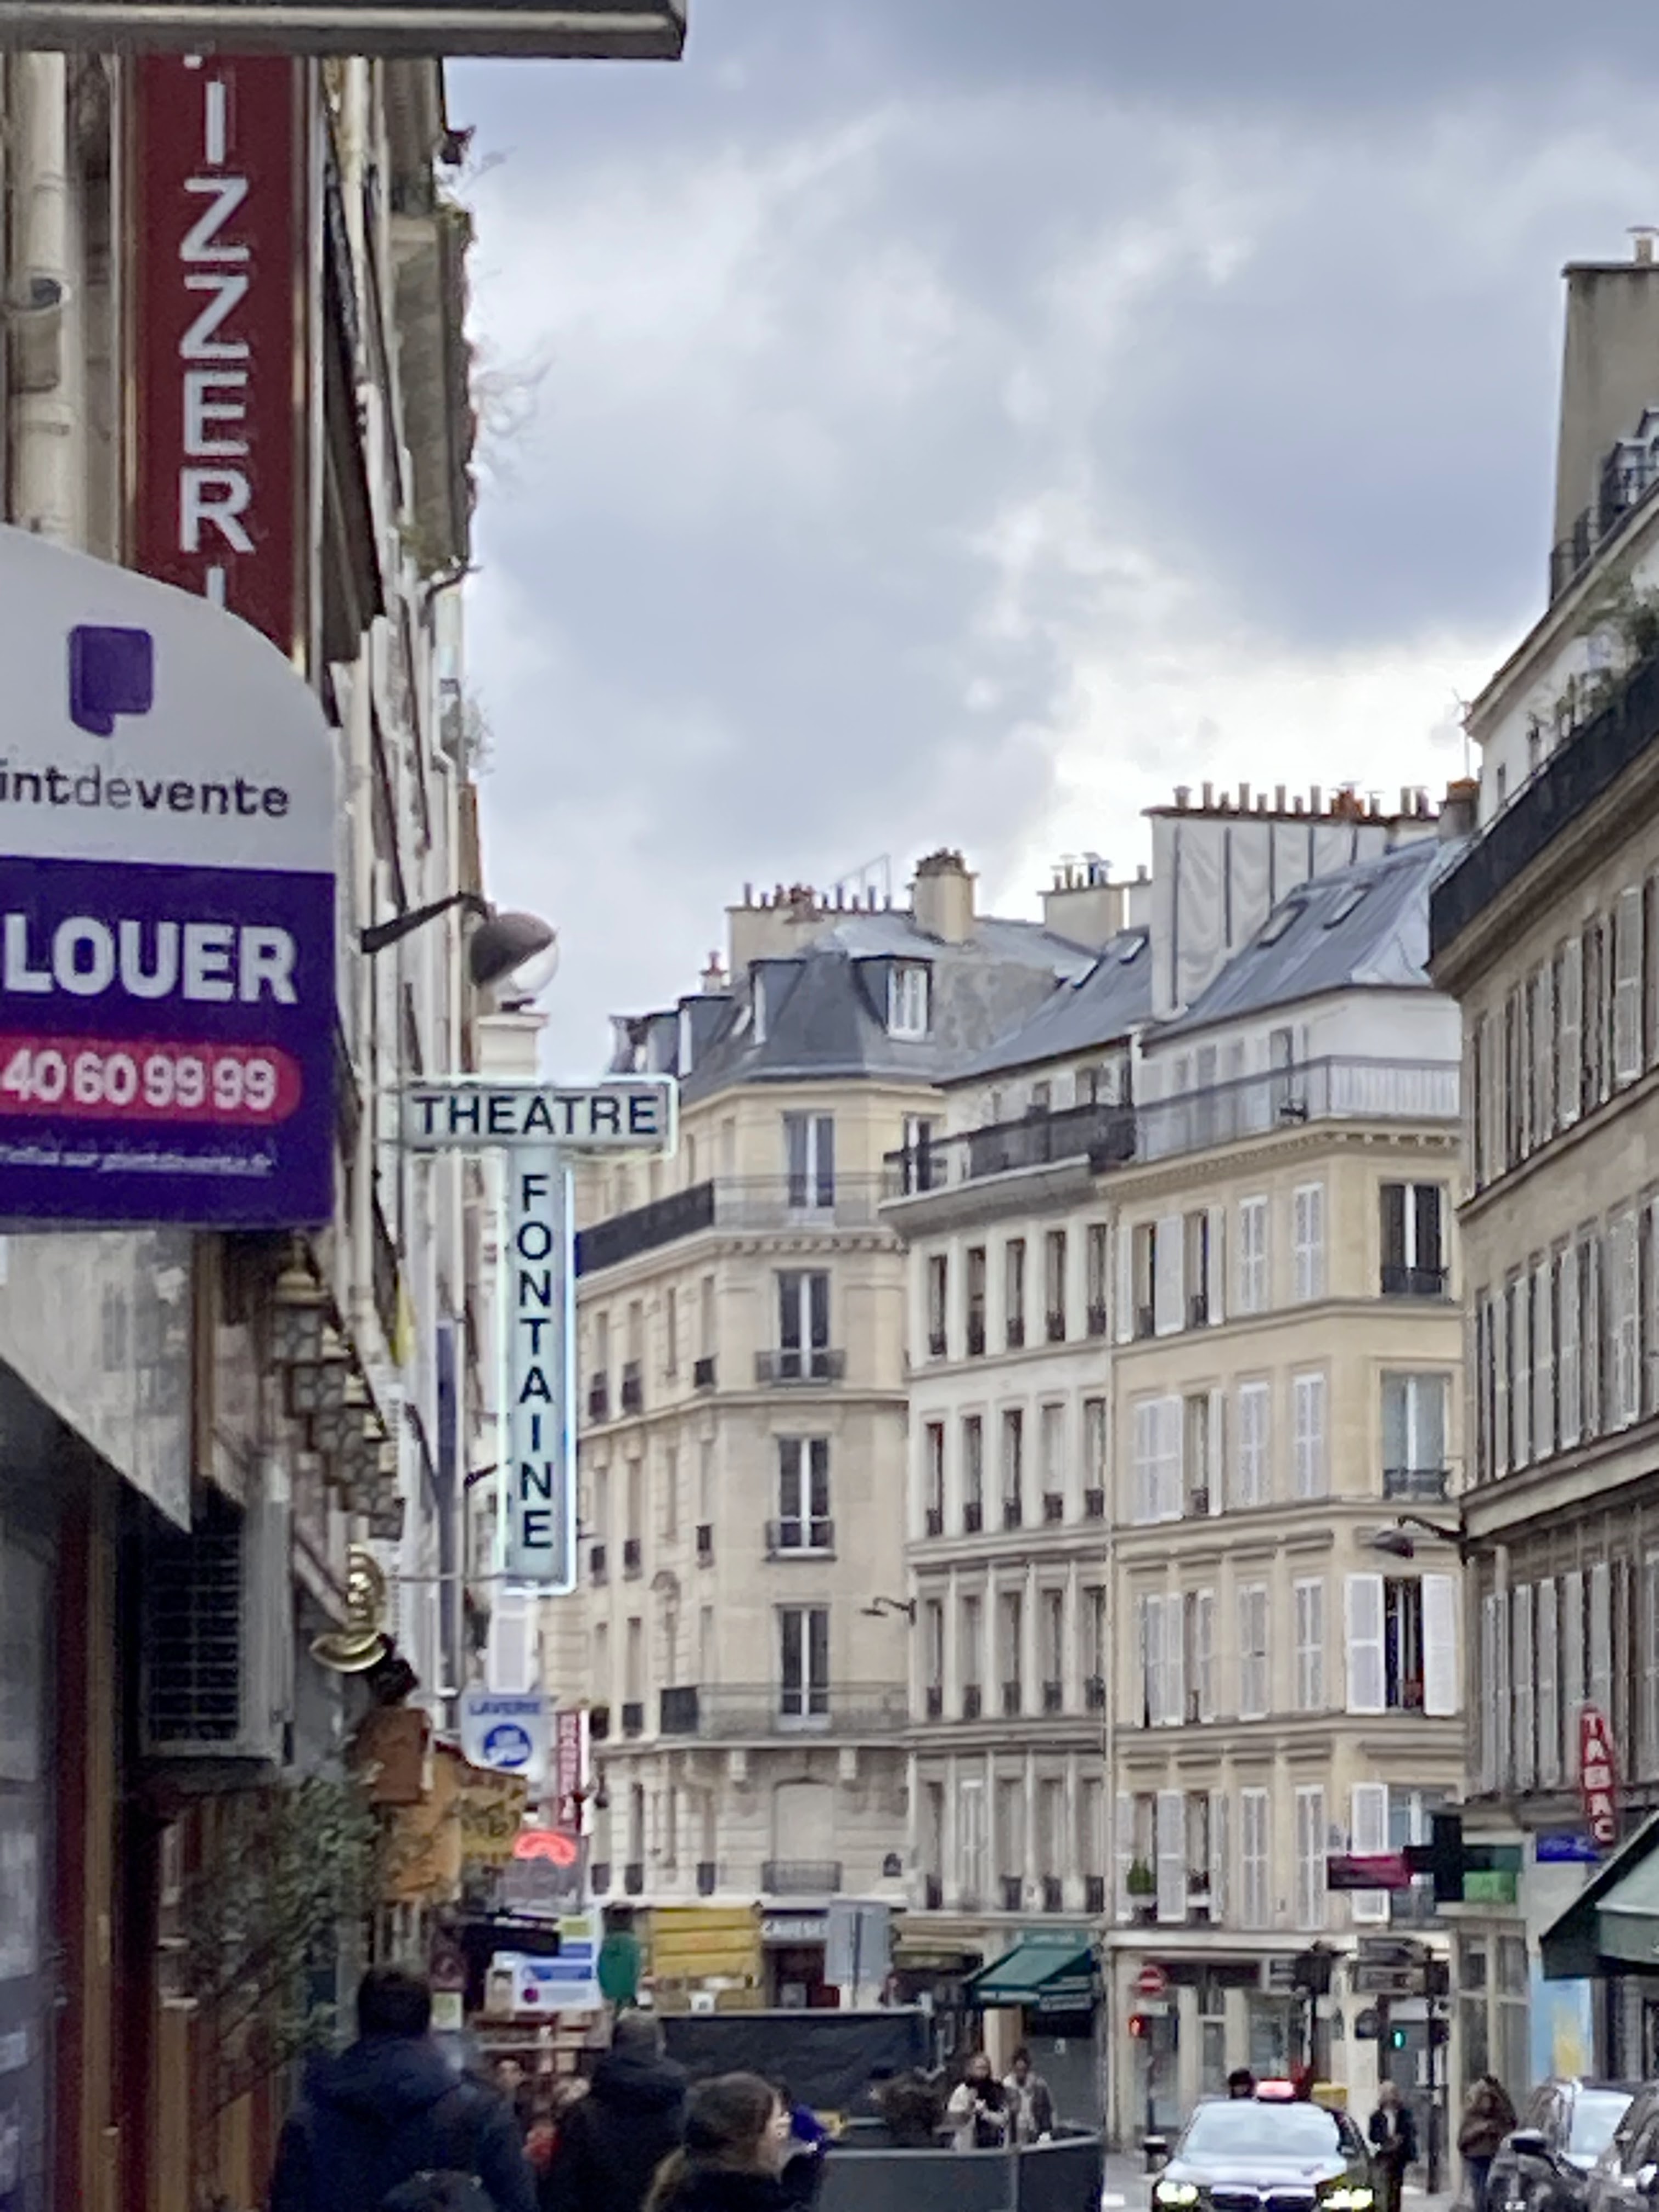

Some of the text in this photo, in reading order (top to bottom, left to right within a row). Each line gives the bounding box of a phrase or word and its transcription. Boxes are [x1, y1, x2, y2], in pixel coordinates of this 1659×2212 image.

[3, 913, 298, 1005] LOUER
[411, 1096, 659, 1135] THEATRE
[516, 1173, 553, 1549] FONTAINE
